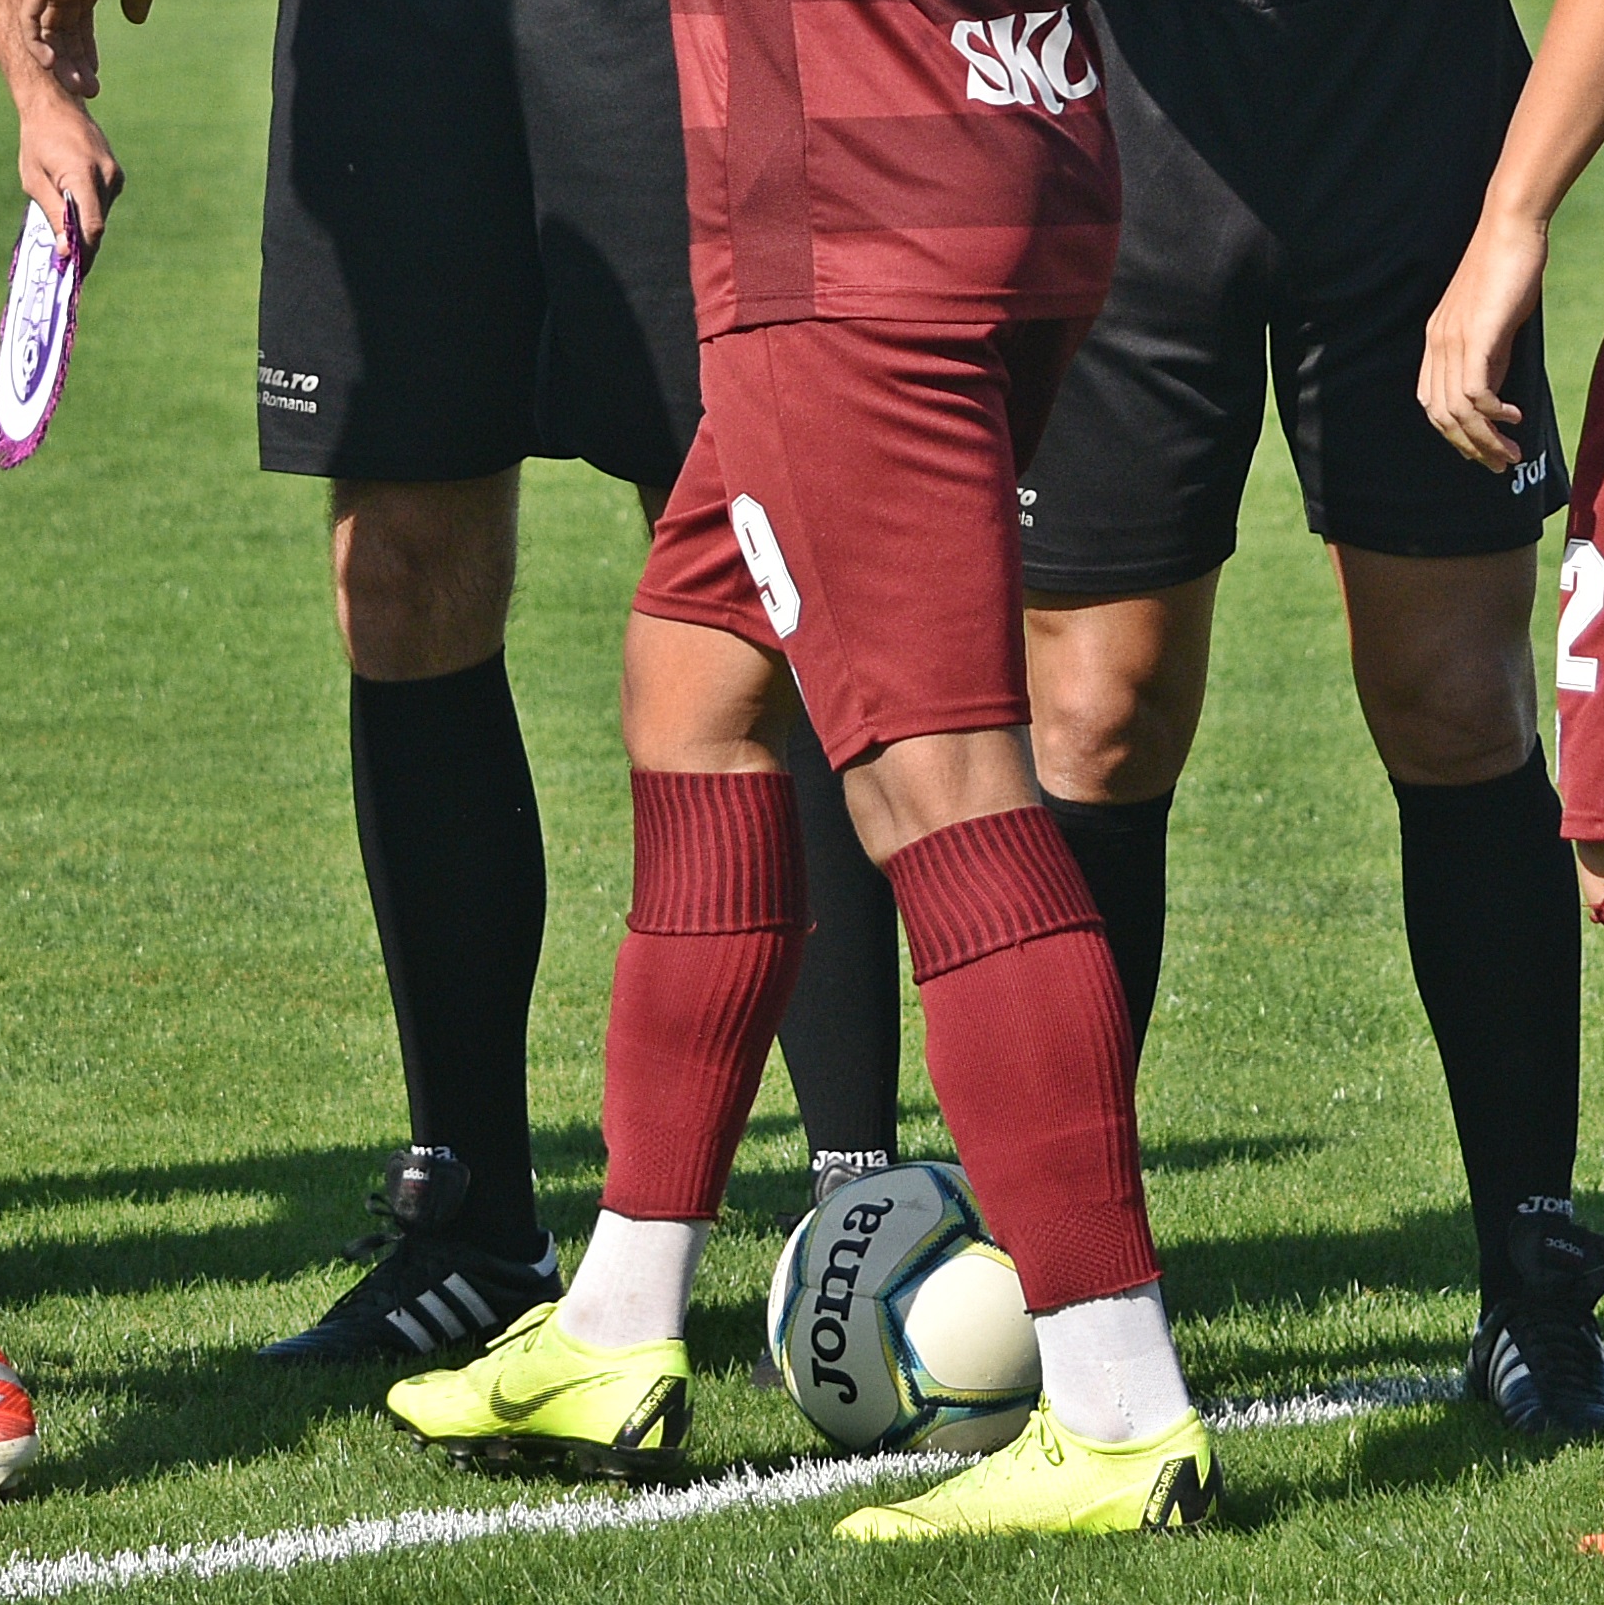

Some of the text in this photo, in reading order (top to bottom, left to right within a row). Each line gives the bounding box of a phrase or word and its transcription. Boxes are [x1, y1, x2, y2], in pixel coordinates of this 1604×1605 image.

[262, 390, 317, 413] Romania
[731, 493, 801, 639] 9
[811, 1197, 895, 1405] Joma
